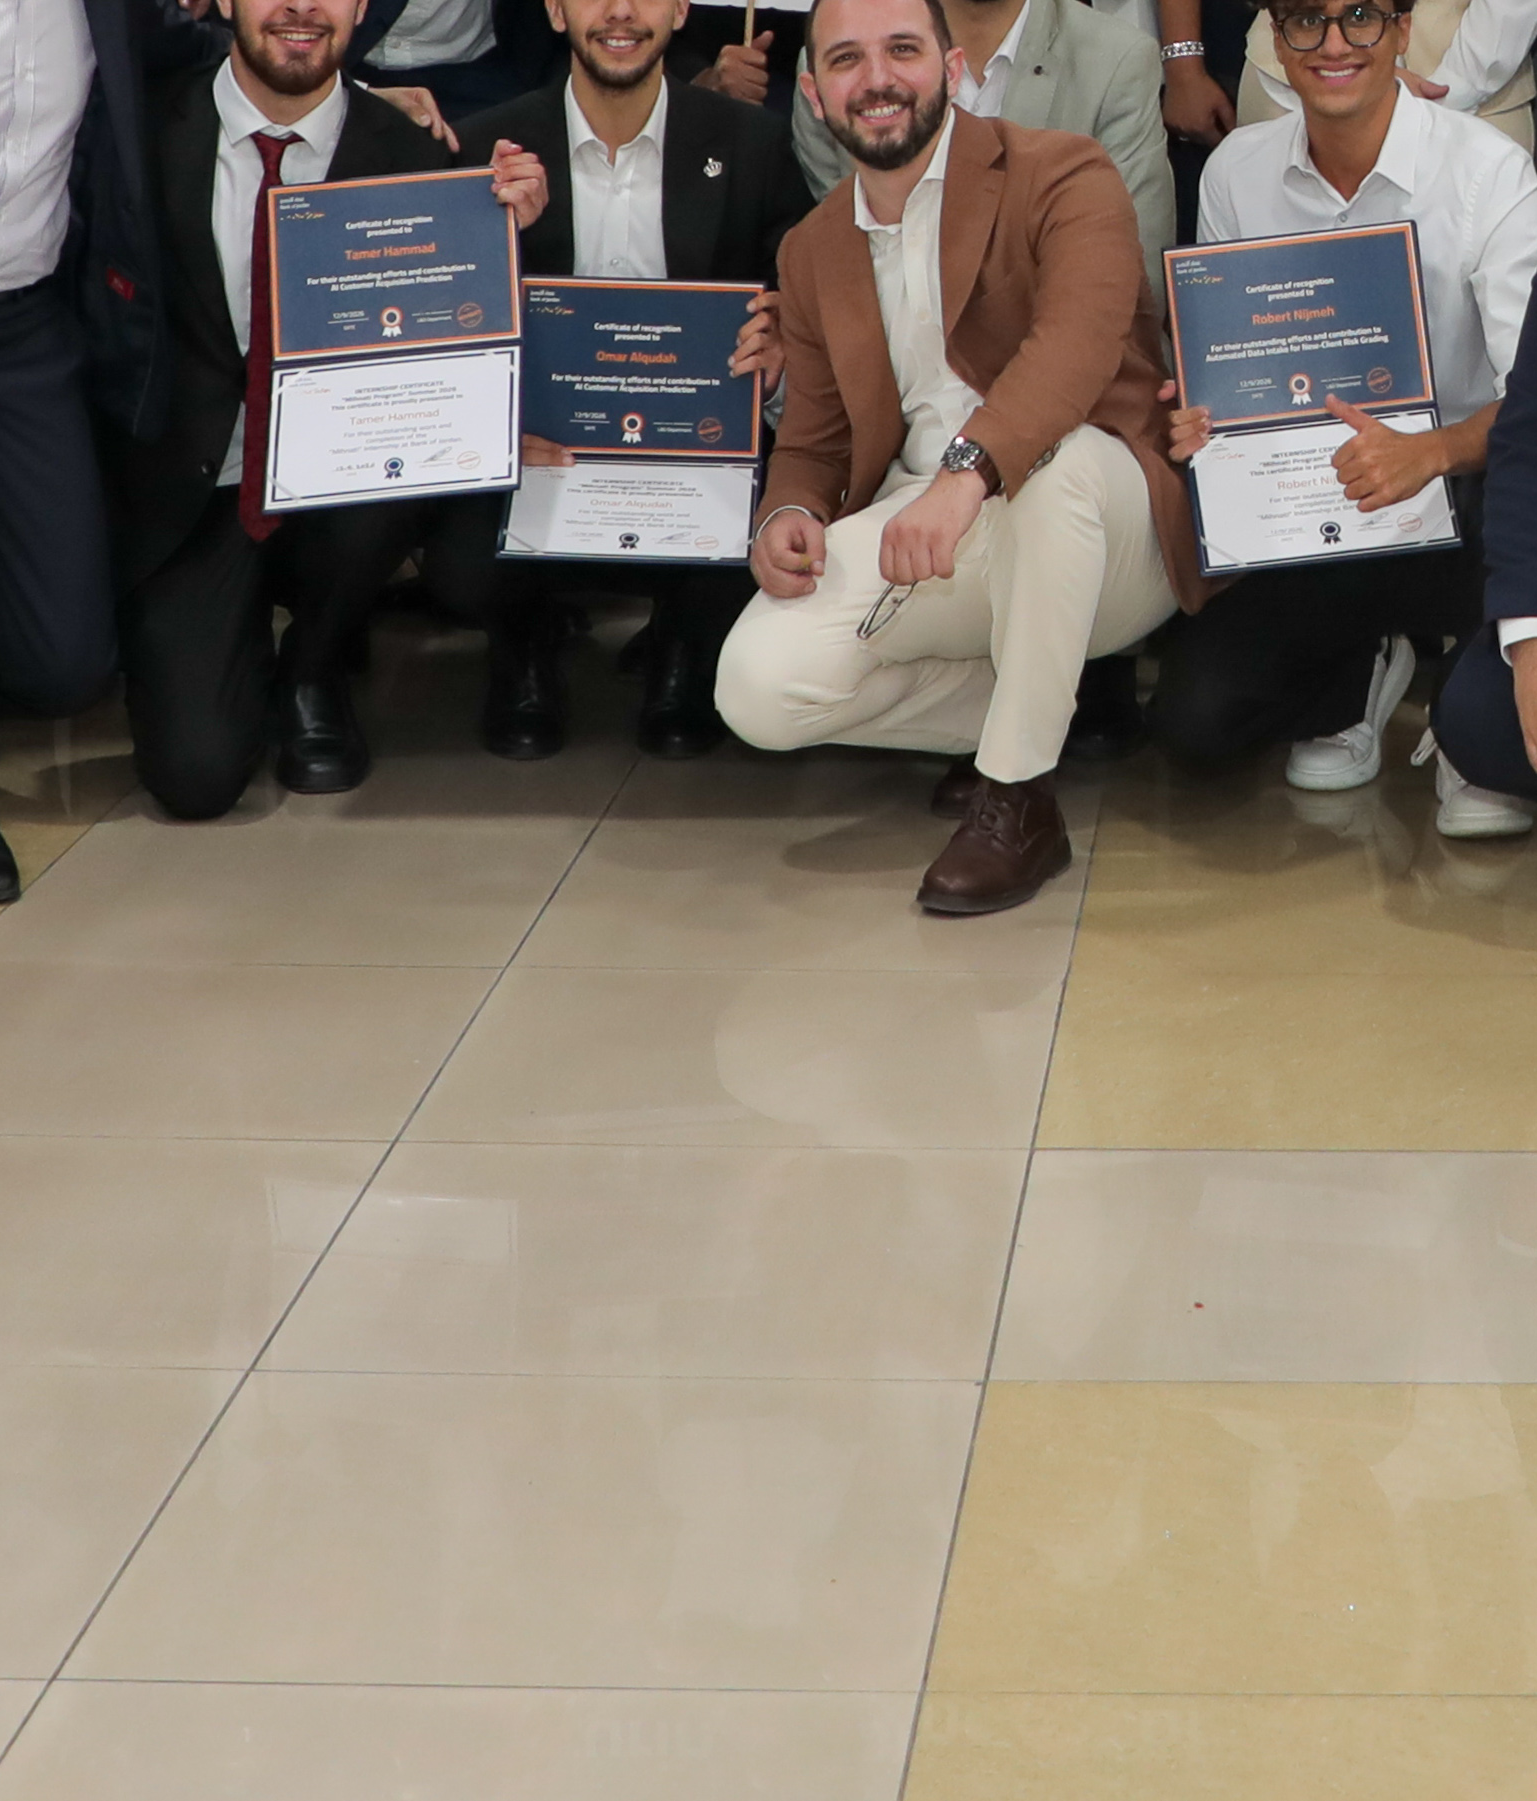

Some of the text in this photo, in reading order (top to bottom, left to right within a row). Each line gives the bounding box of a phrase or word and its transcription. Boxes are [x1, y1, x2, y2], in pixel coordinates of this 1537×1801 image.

[345, 216, 433, 230] Certificate of recognition
[366, 226, 404, 238] presented
[345, 242, 436, 260] Tamer Hammad
[1245, 278, 1334, 294] Certificate of recognition
[1267, 289, 1305, 302] presented
[1252, 306, 1335, 325] Robert Nijmeh
[594, 322, 682, 334] Certificate of recognition
[596, 351, 677, 365] Omar Alqudah
